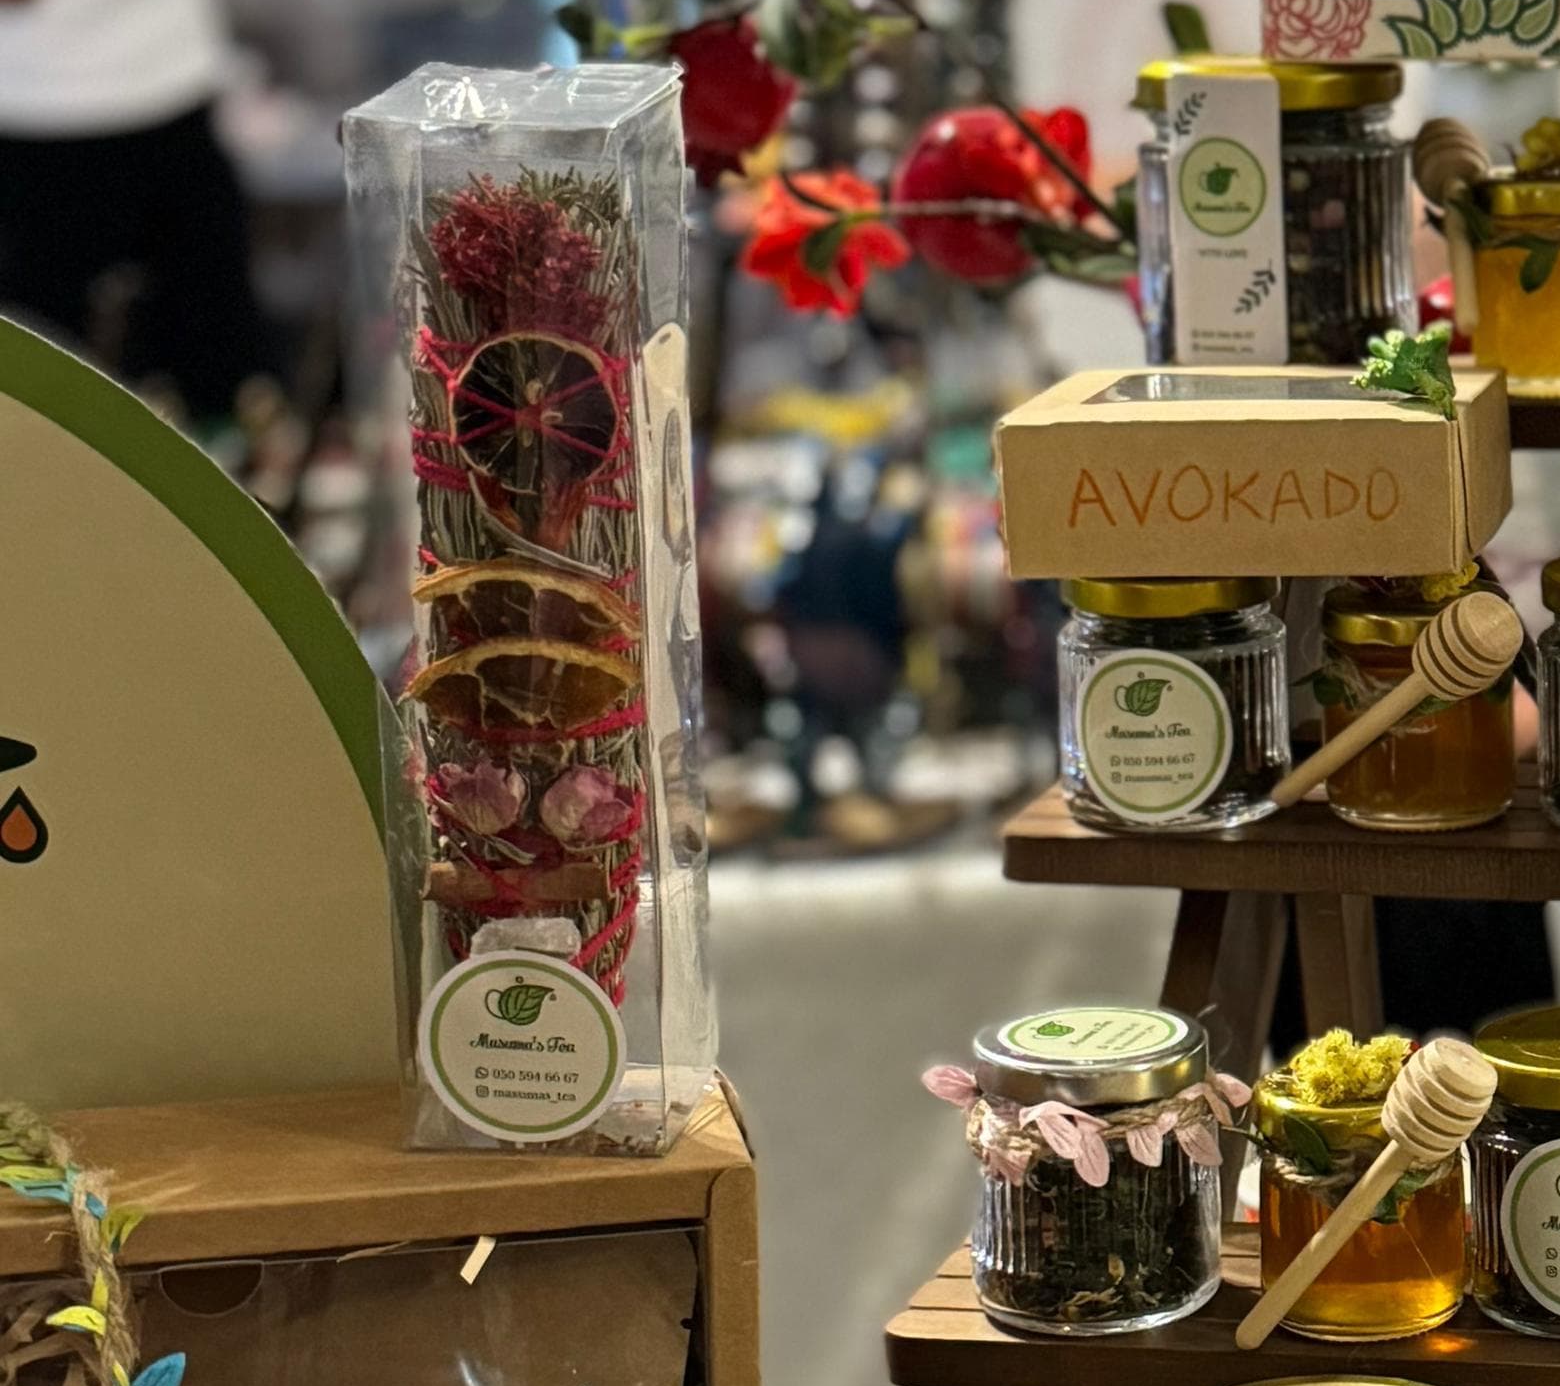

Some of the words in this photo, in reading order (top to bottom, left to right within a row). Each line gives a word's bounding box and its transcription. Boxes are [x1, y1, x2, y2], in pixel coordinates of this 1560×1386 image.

[1068, 464, 1399, 528] AVOKADO
[469, 1033, 545, 1052] Masuma's
[546, 1036, 576, 1053] Tea
